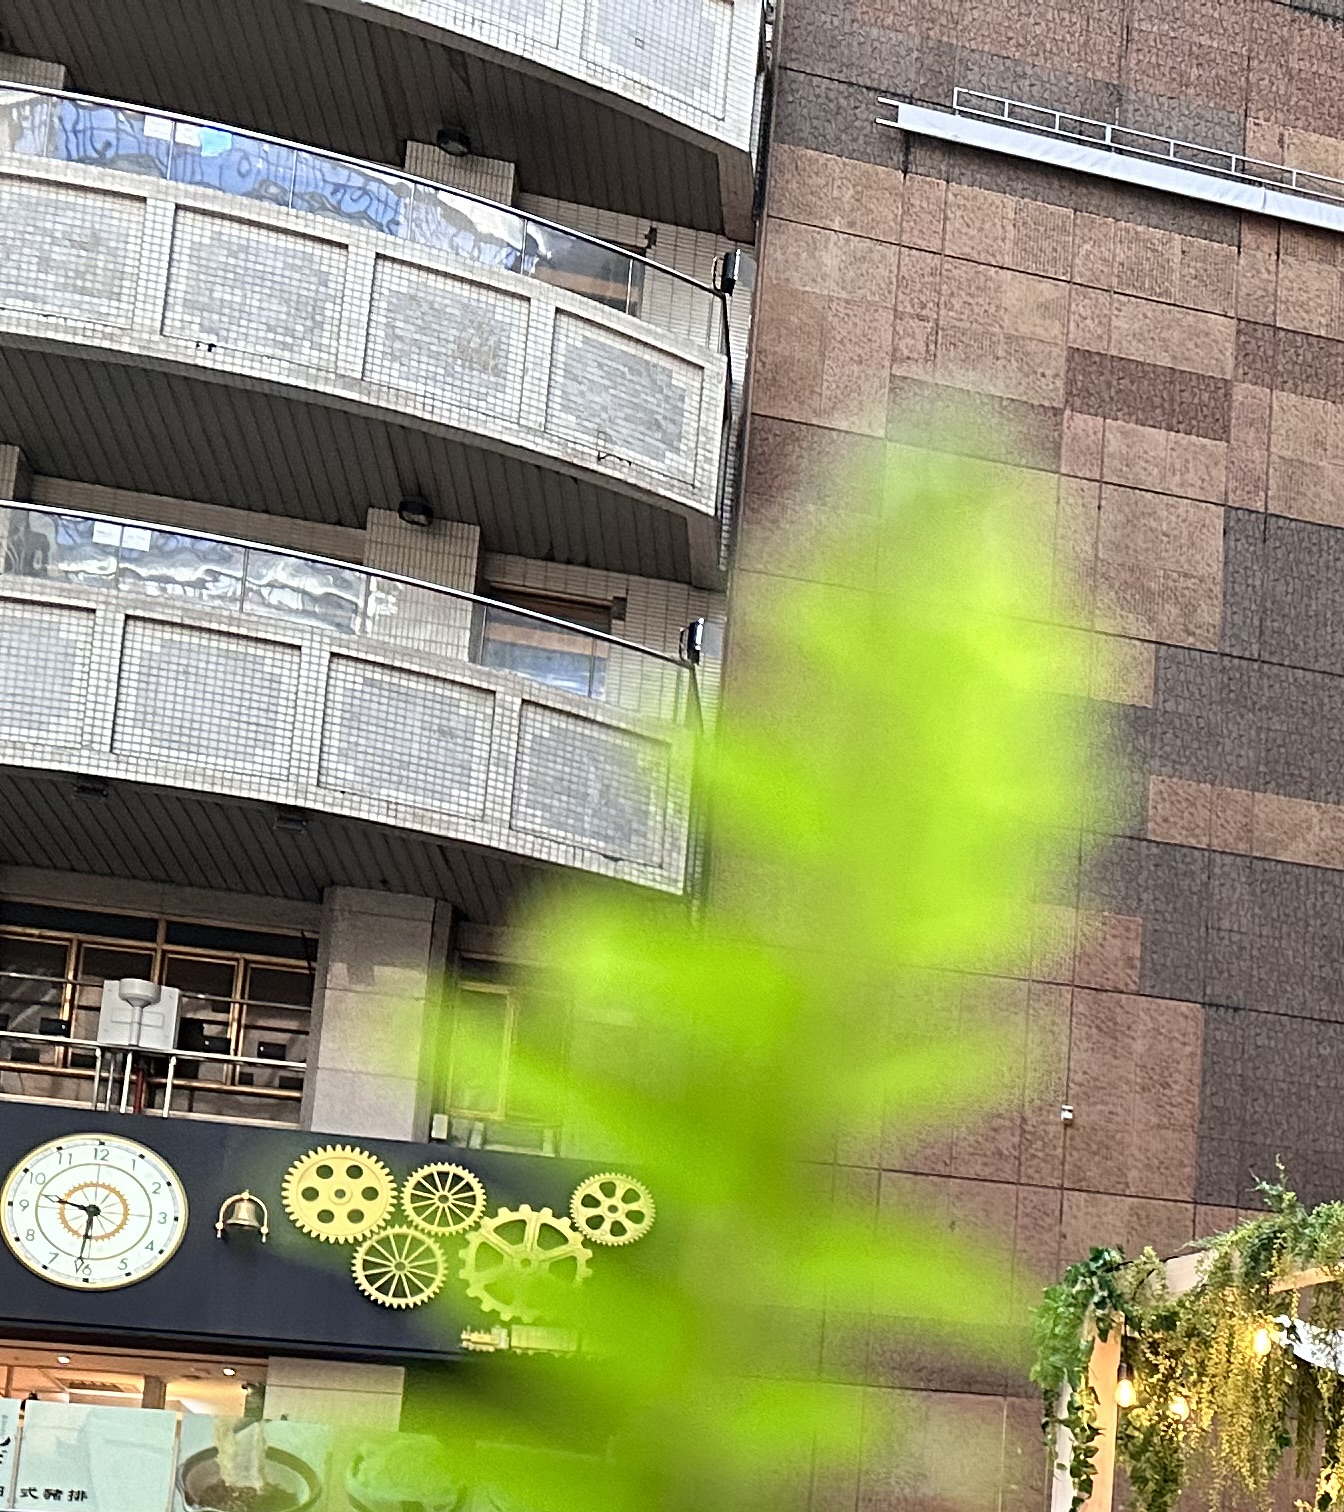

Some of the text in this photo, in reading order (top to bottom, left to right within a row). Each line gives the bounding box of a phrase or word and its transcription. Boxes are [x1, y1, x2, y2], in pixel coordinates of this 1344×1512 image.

[57, 1150, 73, 1166] 11
[93, 1147, 110, 1162] 12
[131, 1158, 137, 1172] 1
[29, 1171, 46, 1186] 10
[151, 1181, 162, 1195] 2
[19, 1199, 30, 1213] 9
[157, 1211, 168, 1225] 3
[25, 1228, 36, 1242] 8
[144, 1239, 154, 1252] 4
[48, 1251, 60, 1265] 7
[117, 1257, 129, 1271] 5
[81, 1263, 92, 1277] 6
